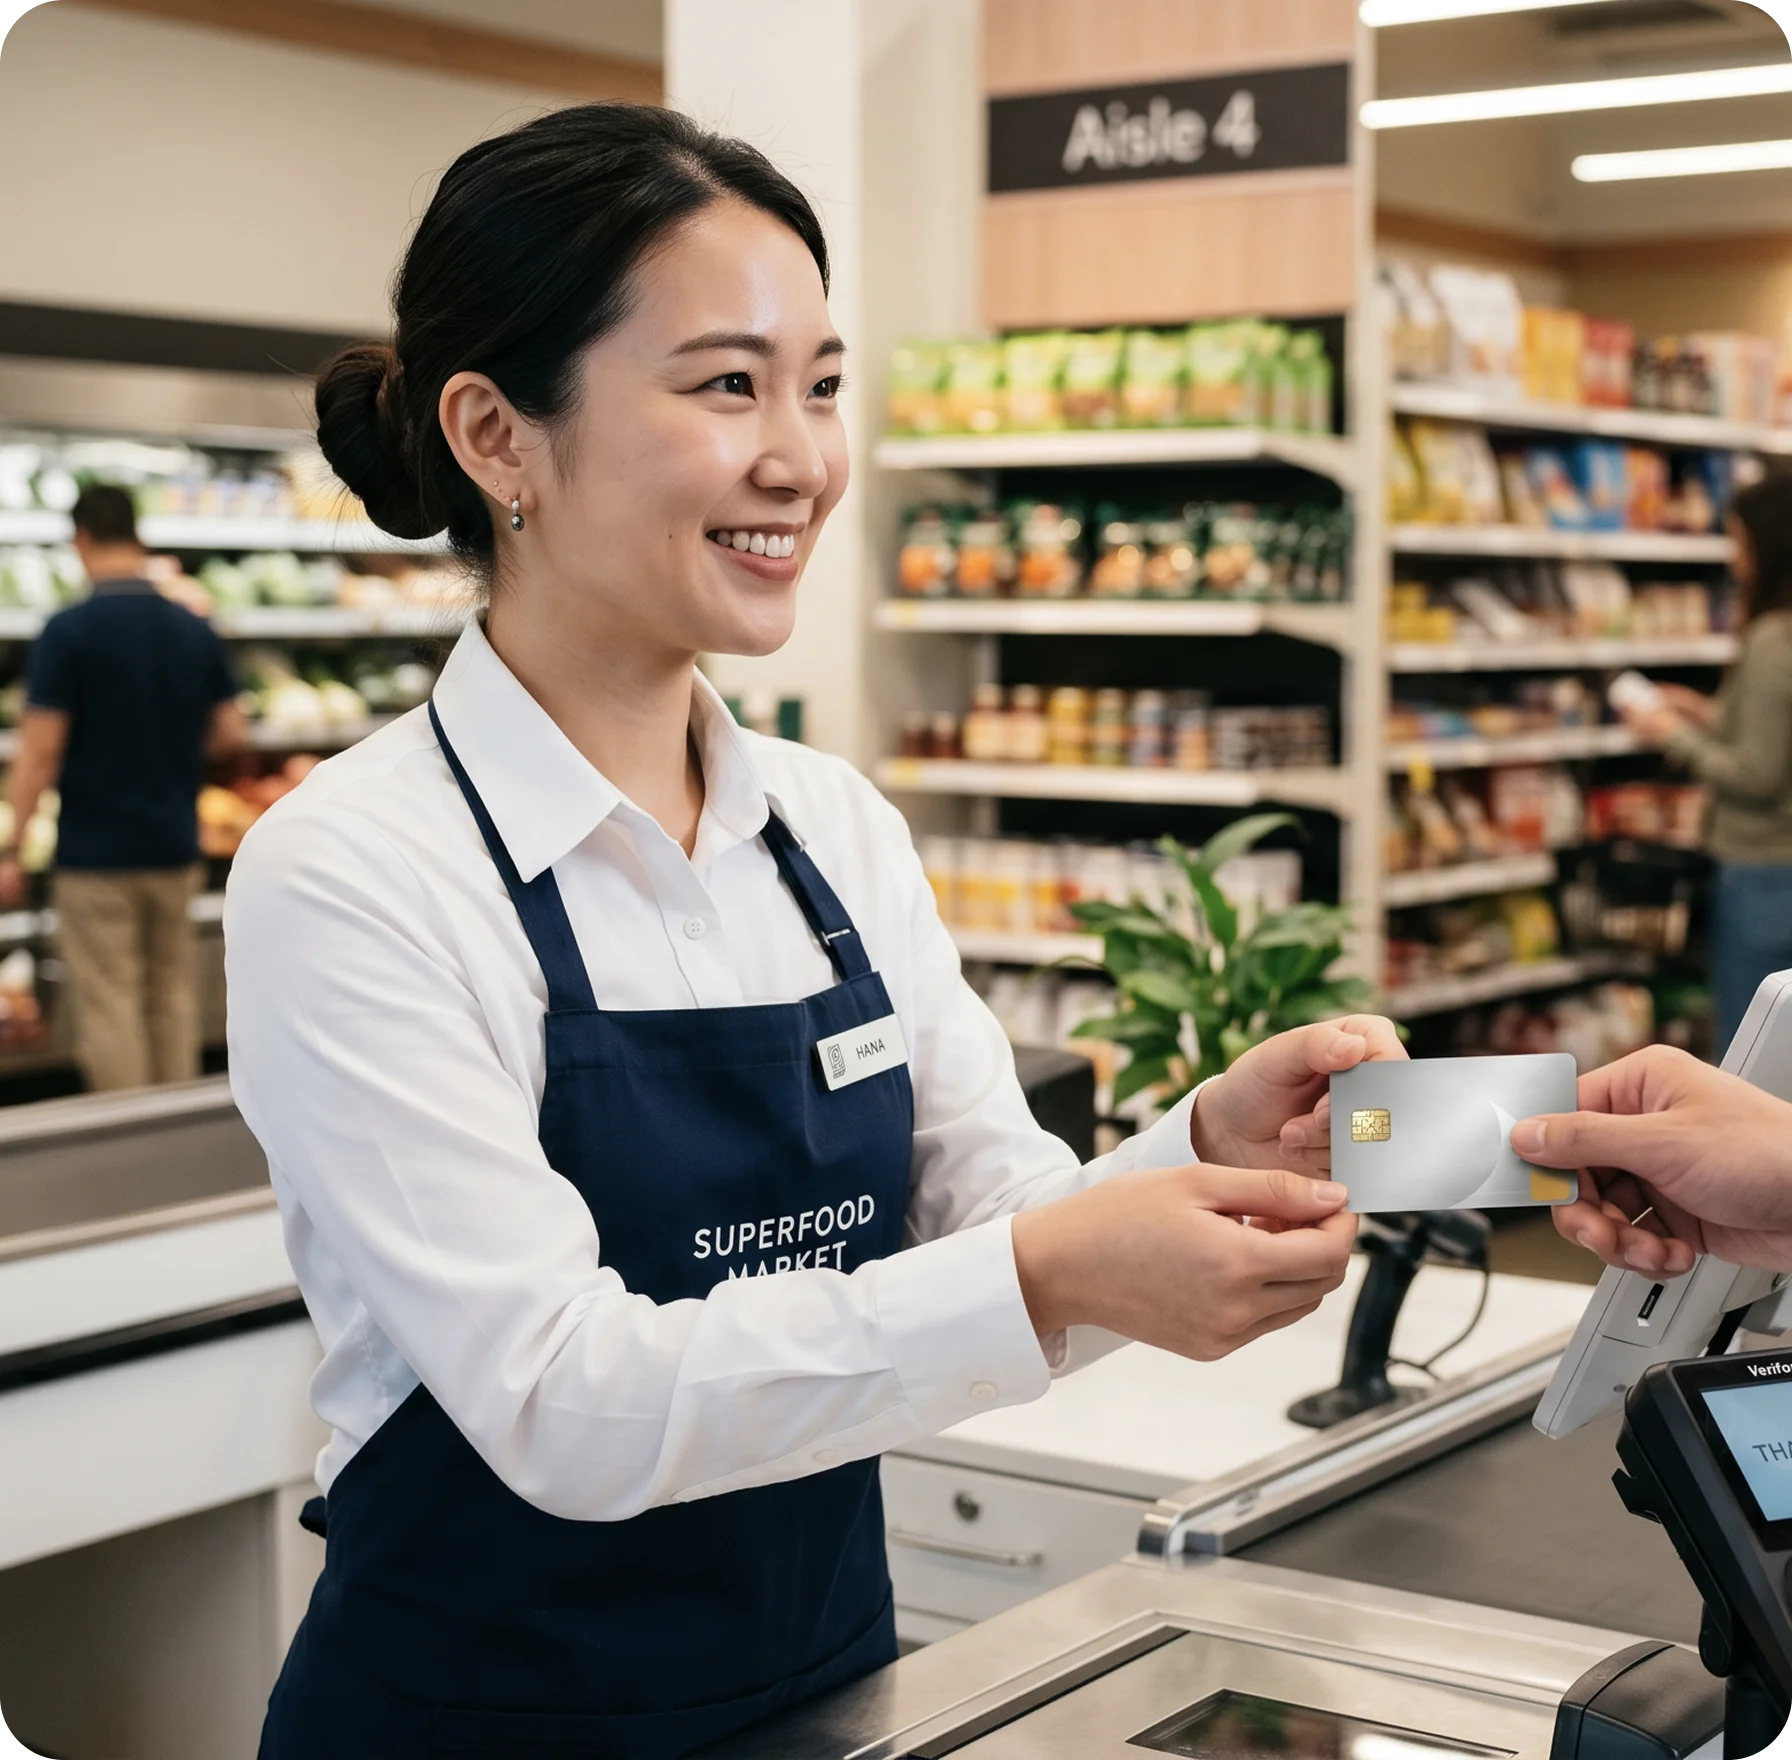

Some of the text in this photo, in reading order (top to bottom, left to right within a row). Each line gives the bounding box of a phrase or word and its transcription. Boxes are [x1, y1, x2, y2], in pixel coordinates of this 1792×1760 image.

[1062, 89, 1259, 172] Aisle 4
[855, 1038, 886, 1060] HANA
[693, 1194, 876, 1259] SUPERFOOD
[1747, 1361, 1792, 1377] Verifo
